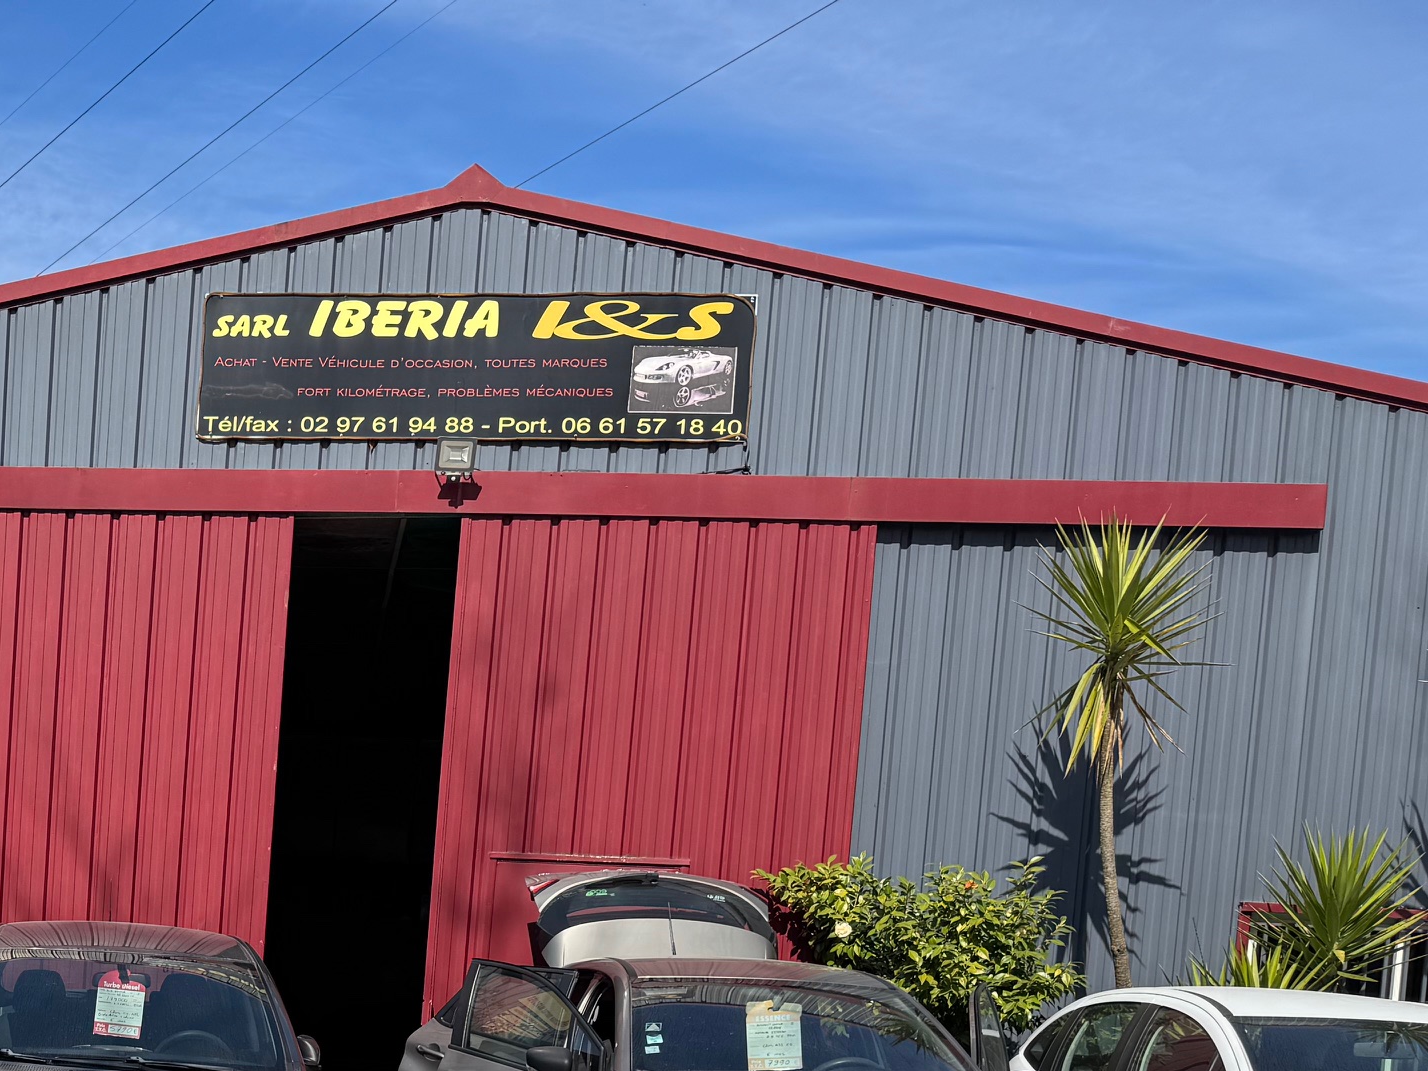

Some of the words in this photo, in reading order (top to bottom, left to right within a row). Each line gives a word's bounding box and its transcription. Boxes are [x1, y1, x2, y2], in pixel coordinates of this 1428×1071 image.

[212, 314, 290, 339] SARL
[308, 300, 500, 341] IBERIA
[532, 300, 735, 341] I&S
[272, 357, 314, 369] VENTE
[485, 358, 537, 369] TOUTES
[542, 358, 608, 370] MARQUES
[297, 387, 332, 397] FORT
[336, 384, 430, 400] KILOMÉTRAGE,
[437, 384, 520, 398] PROBLÈMES
[526, 384, 614, 399] MÉCANIQUES
[203, 415, 280, 433] Tél/fax
[300, 416, 329, 433] 02
[336, 416, 366, 433] 97
[372, 416, 399, 433] 61
[408, 416, 437, 433] 94
[444, 416, 474, 434] 88
[498, 416, 553, 434] Port.
[562, 417, 591, 434] 06
[598, 418, 626, 434] 61
[636, 418, 668, 434] 57
[676, 418, 704, 435] 18
[711, 419, 743, 436] 40
[103, 980, 121, 989] Turbo
[121, 983, 141, 991] Diesel
[755, 1014, 791, 1022] ESSENCE
